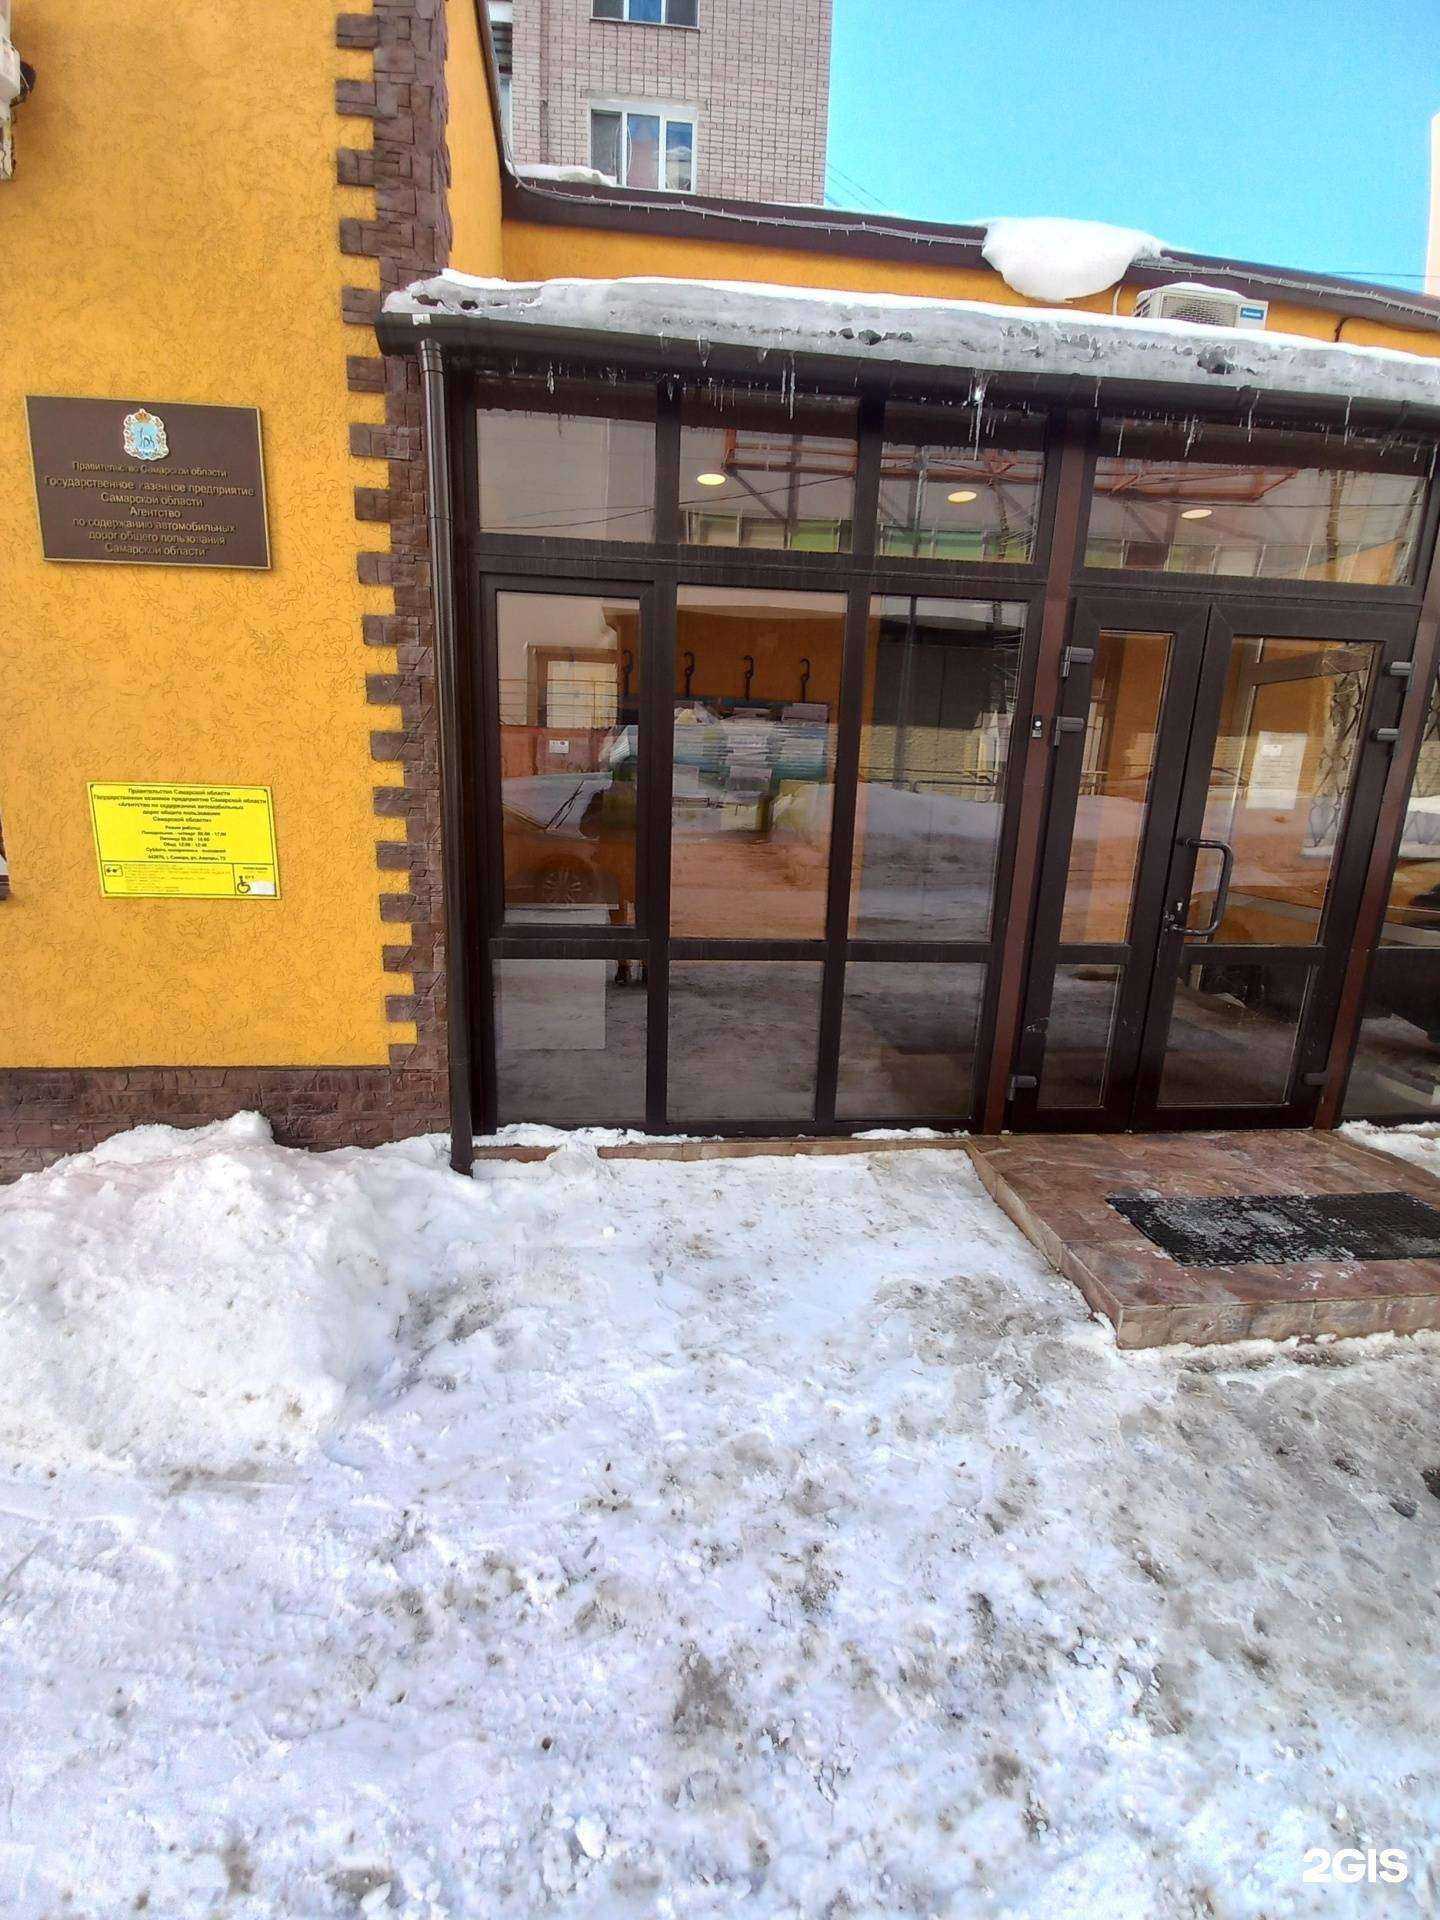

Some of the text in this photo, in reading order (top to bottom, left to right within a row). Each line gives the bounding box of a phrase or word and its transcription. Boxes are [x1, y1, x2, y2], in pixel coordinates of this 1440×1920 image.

[190, 467, 228, 478] области
[45, 476, 135, 490] Государственное
[188, 484, 256, 497] предприятие
[101, 492, 204, 507] Самарской области
[130, 506, 181, 518] Агентство
[73, 519, 86, 527] по
[156, 522, 236, 534] автомобильных
[89, 531, 119, 541] дорог
[164, 545, 206, 556] области
